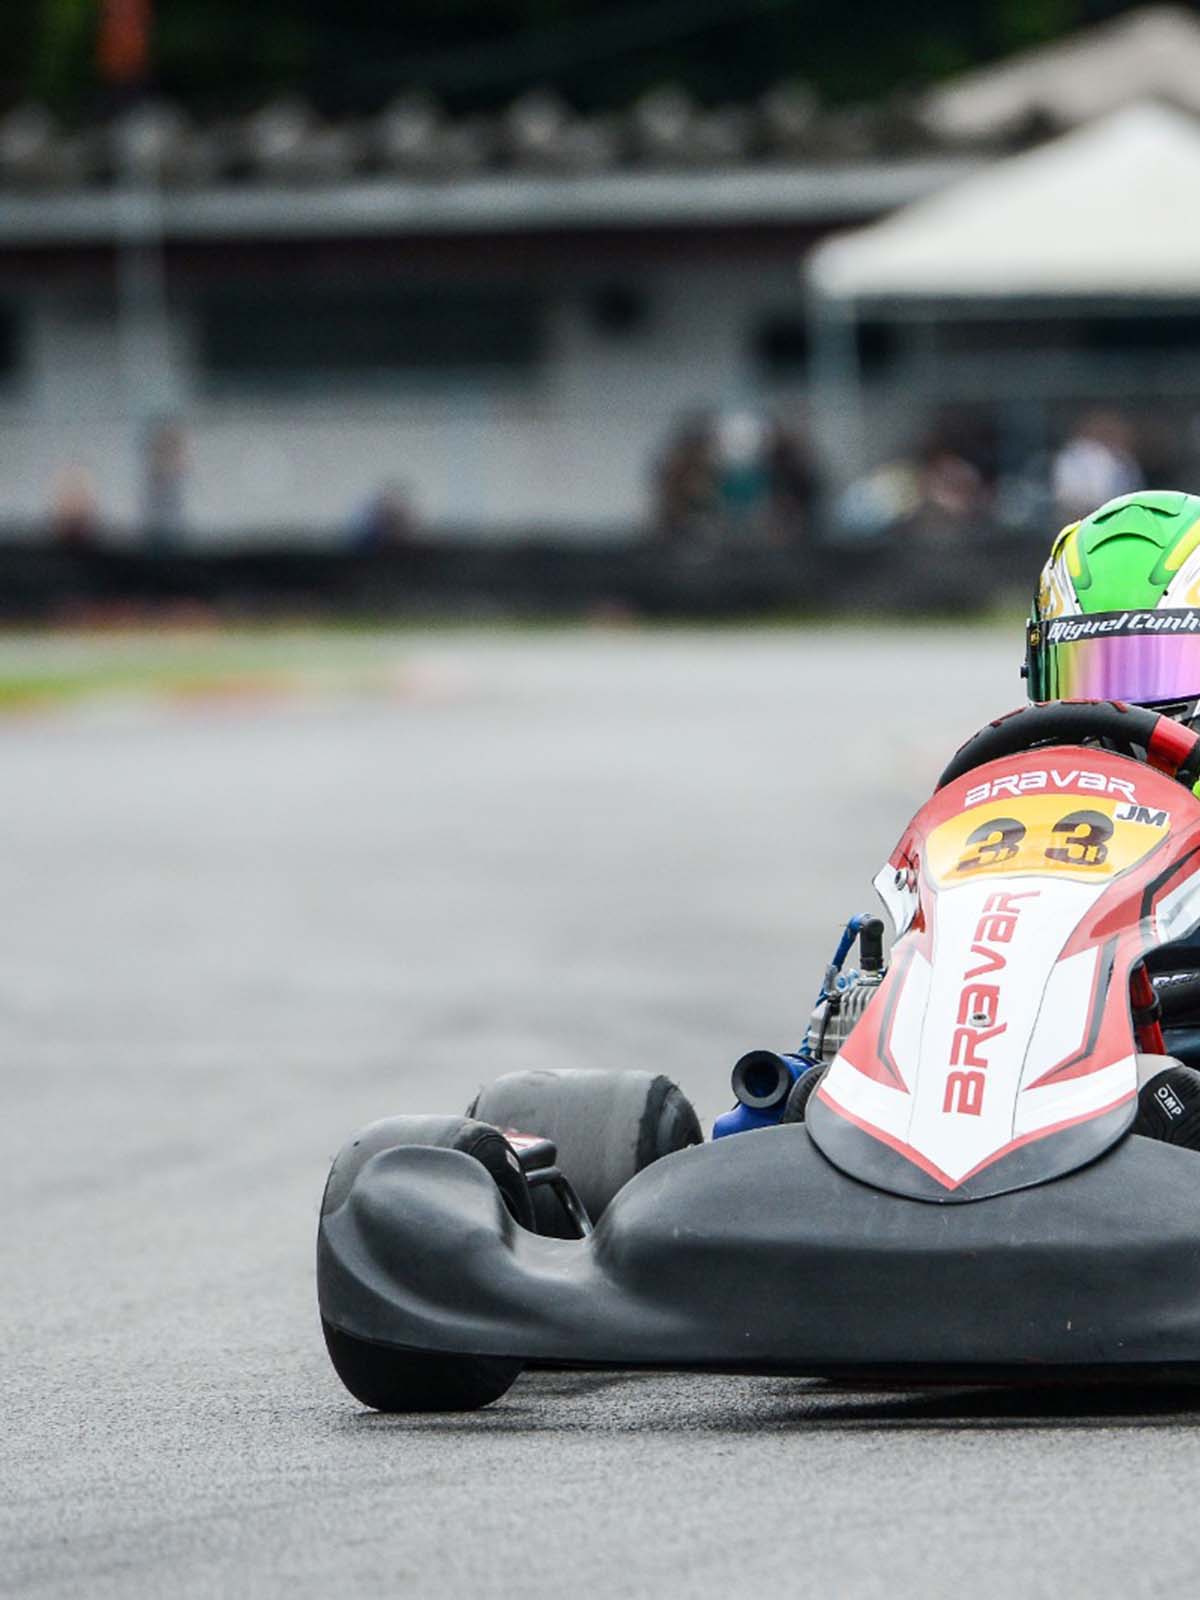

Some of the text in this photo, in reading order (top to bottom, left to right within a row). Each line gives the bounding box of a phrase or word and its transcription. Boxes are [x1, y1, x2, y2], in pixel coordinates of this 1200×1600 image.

[1047, 613, 1128, 640] Miguel
[1116, 806, 1167, 827] JM
[1157, 1087, 1183, 1115] OMP
